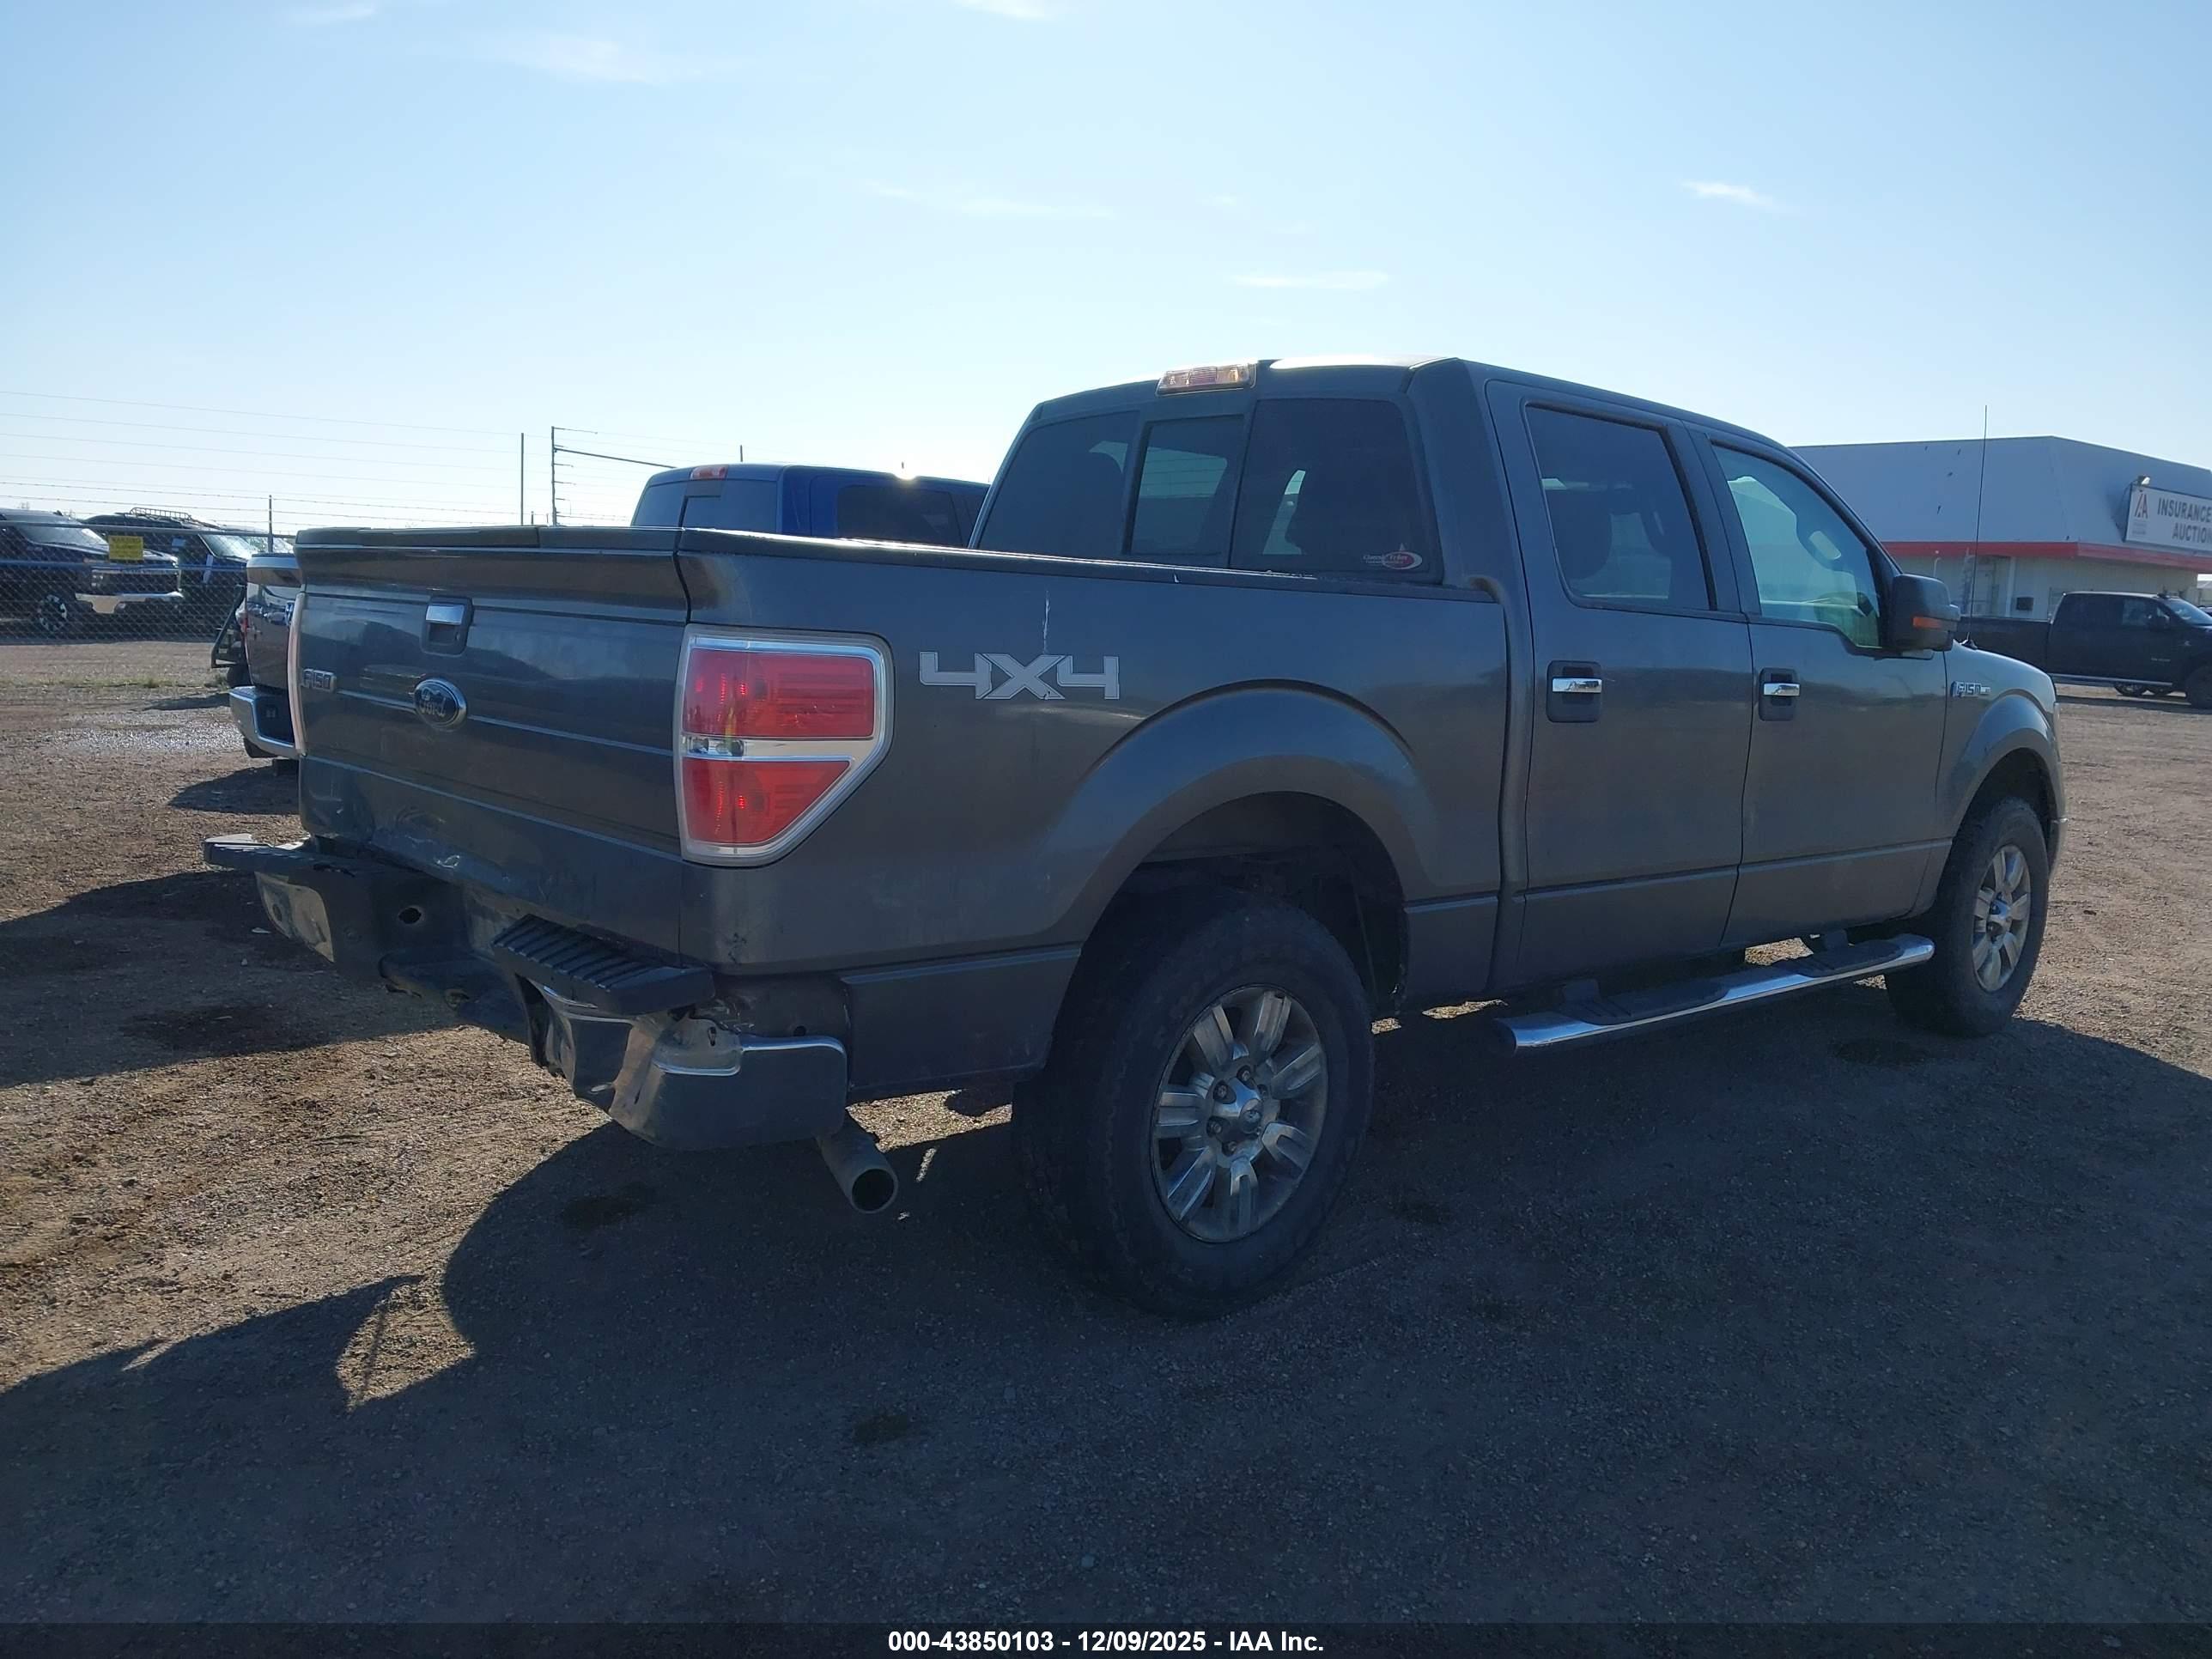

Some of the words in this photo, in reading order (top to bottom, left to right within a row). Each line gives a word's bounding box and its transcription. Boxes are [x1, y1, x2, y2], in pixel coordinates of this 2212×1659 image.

[2157, 496, 2212, 523] INSURANCE
[919, 651, 1120, 700] 4X4
[420, 686, 448, 718] Ford
